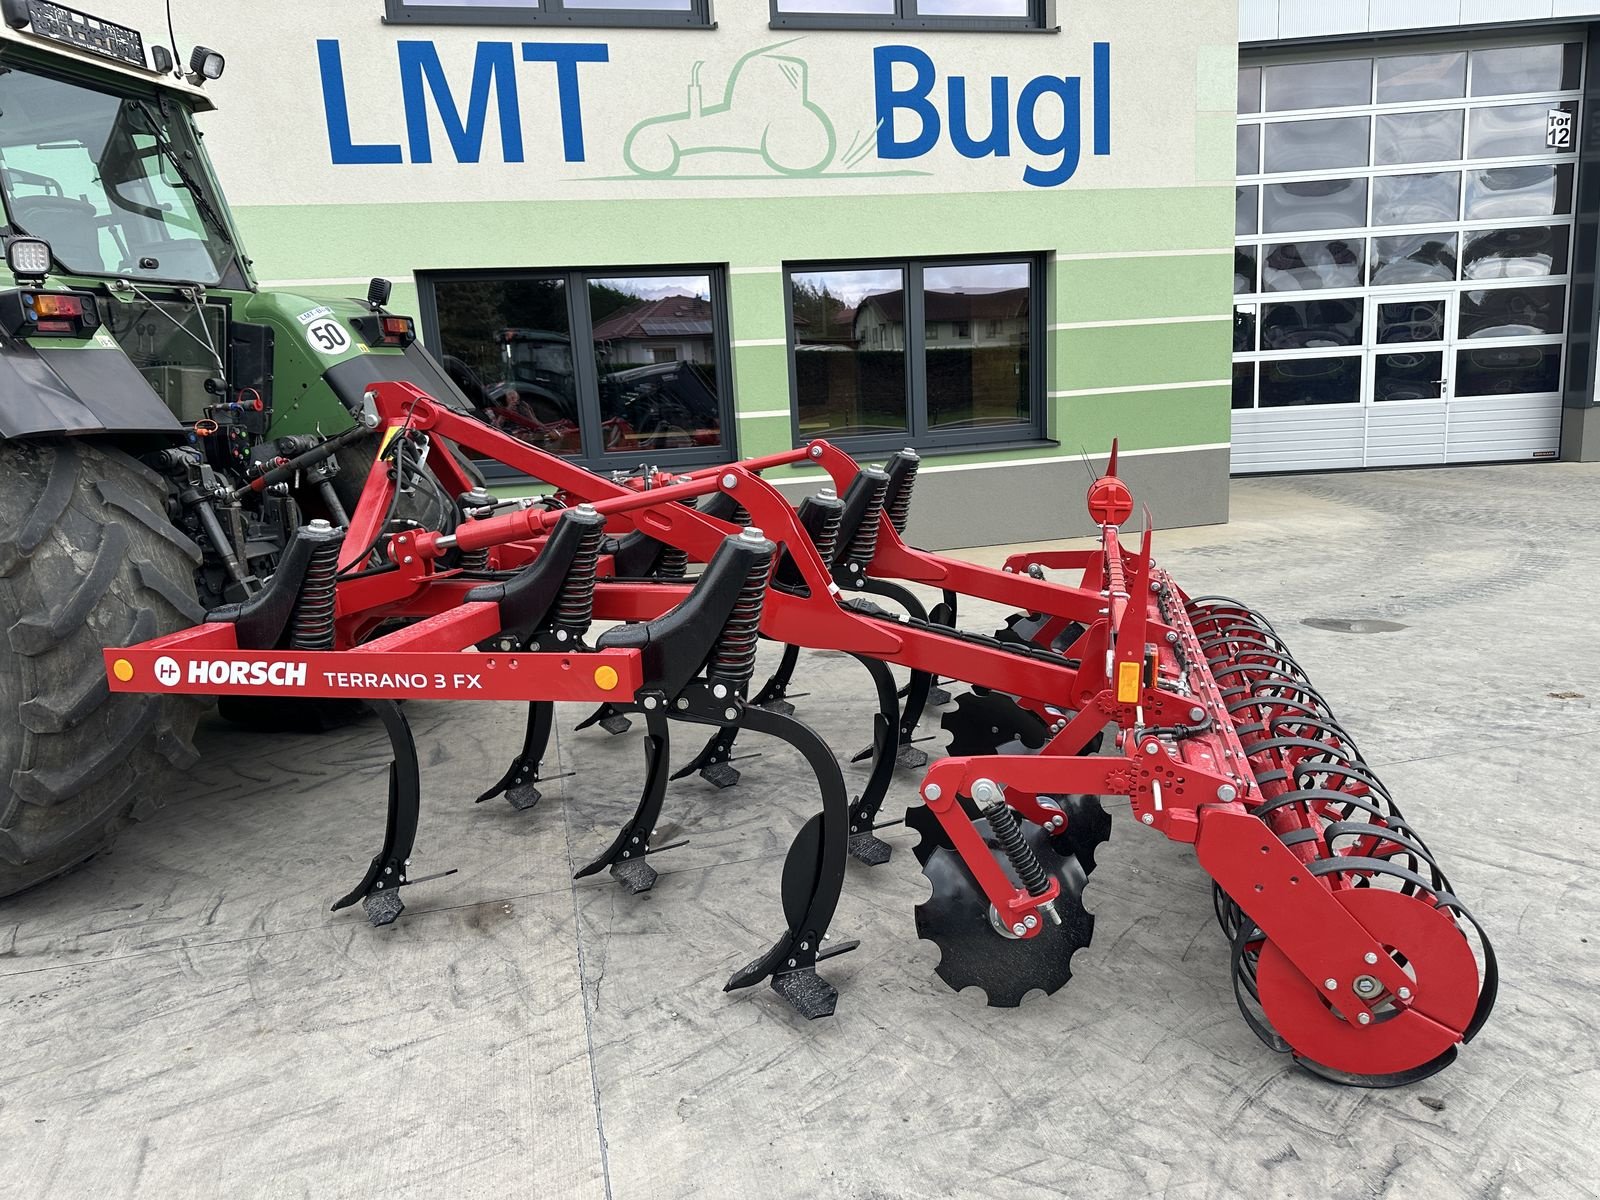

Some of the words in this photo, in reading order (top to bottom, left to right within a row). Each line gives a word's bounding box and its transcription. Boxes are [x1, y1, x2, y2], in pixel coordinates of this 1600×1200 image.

[317, 40, 608, 164] LMT
[874, 43, 1109, 186] Bugl
[1549, 116, 1570, 126] Tor
[1548, 128, 1569, 145] 12
[311, 323, 346, 350] 50
[187, 660, 307, 686] HORSCH
[323, 672, 428, 689] TERRANO
[434, 674, 447, 689] 3
[453, 674, 483, 689] FX
